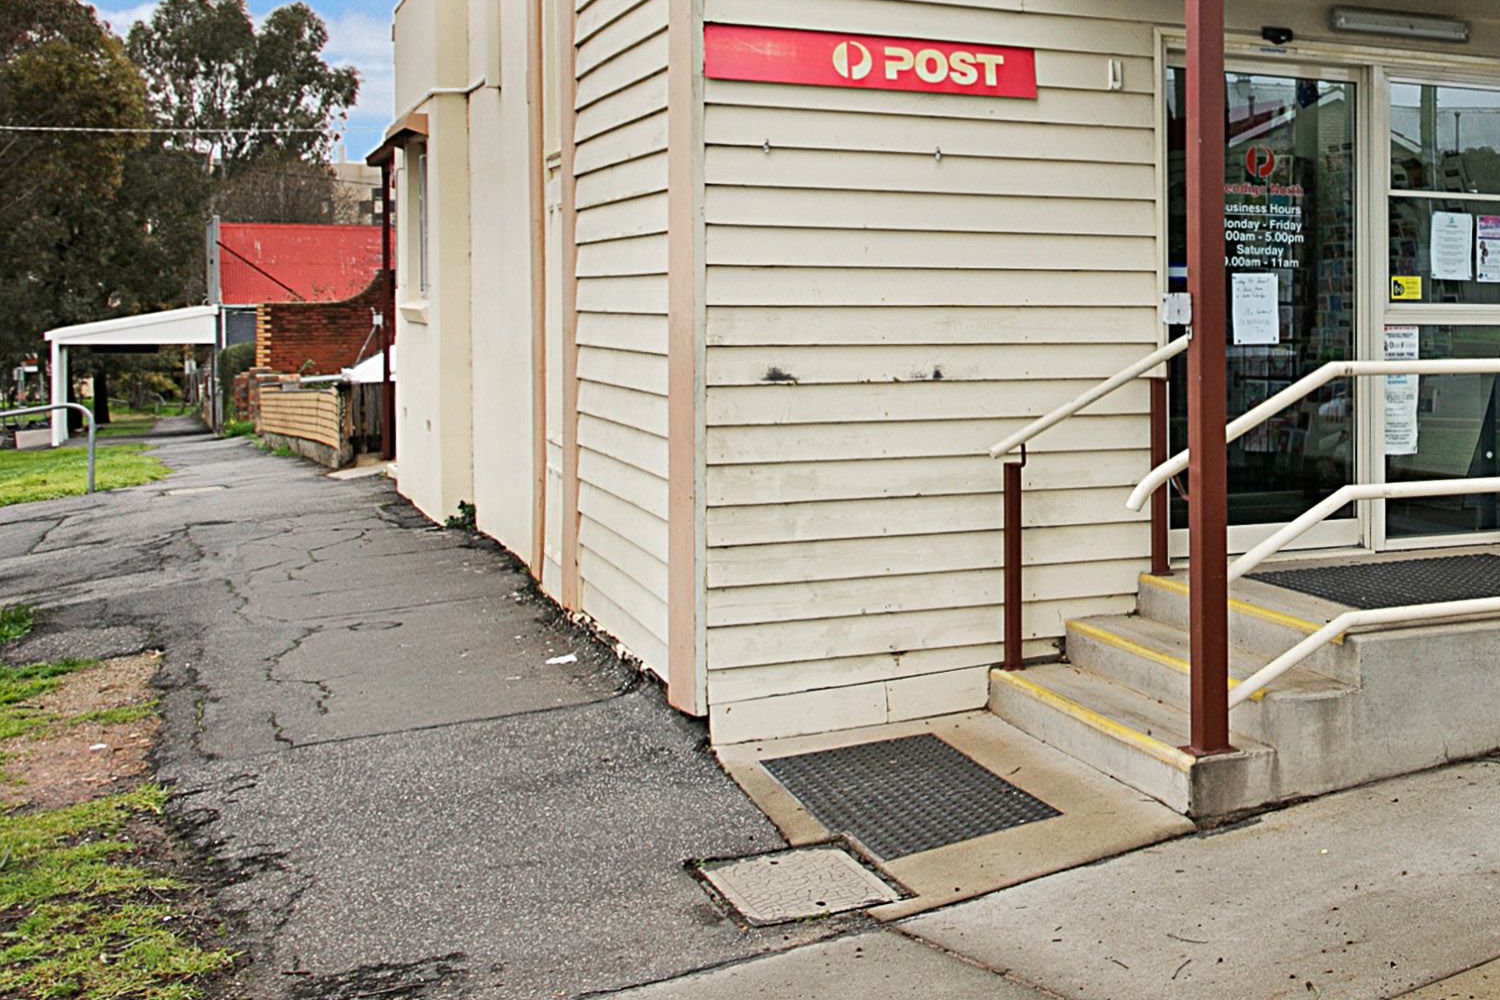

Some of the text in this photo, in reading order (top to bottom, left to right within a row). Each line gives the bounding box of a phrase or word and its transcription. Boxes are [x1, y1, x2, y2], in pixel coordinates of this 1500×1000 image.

[884, 46, 1004, 87] POST
[1224, 183, 1266, 197] endigo
[1225, 202, 1302, 215] usiness Hours
[1269, 219, 1302, 233] Friday
[1264, 231, 1304, 245] 5.00pm
[1236, 243, 1284, 257] Saturday
[1271, 257, 1299, 268] 11am
